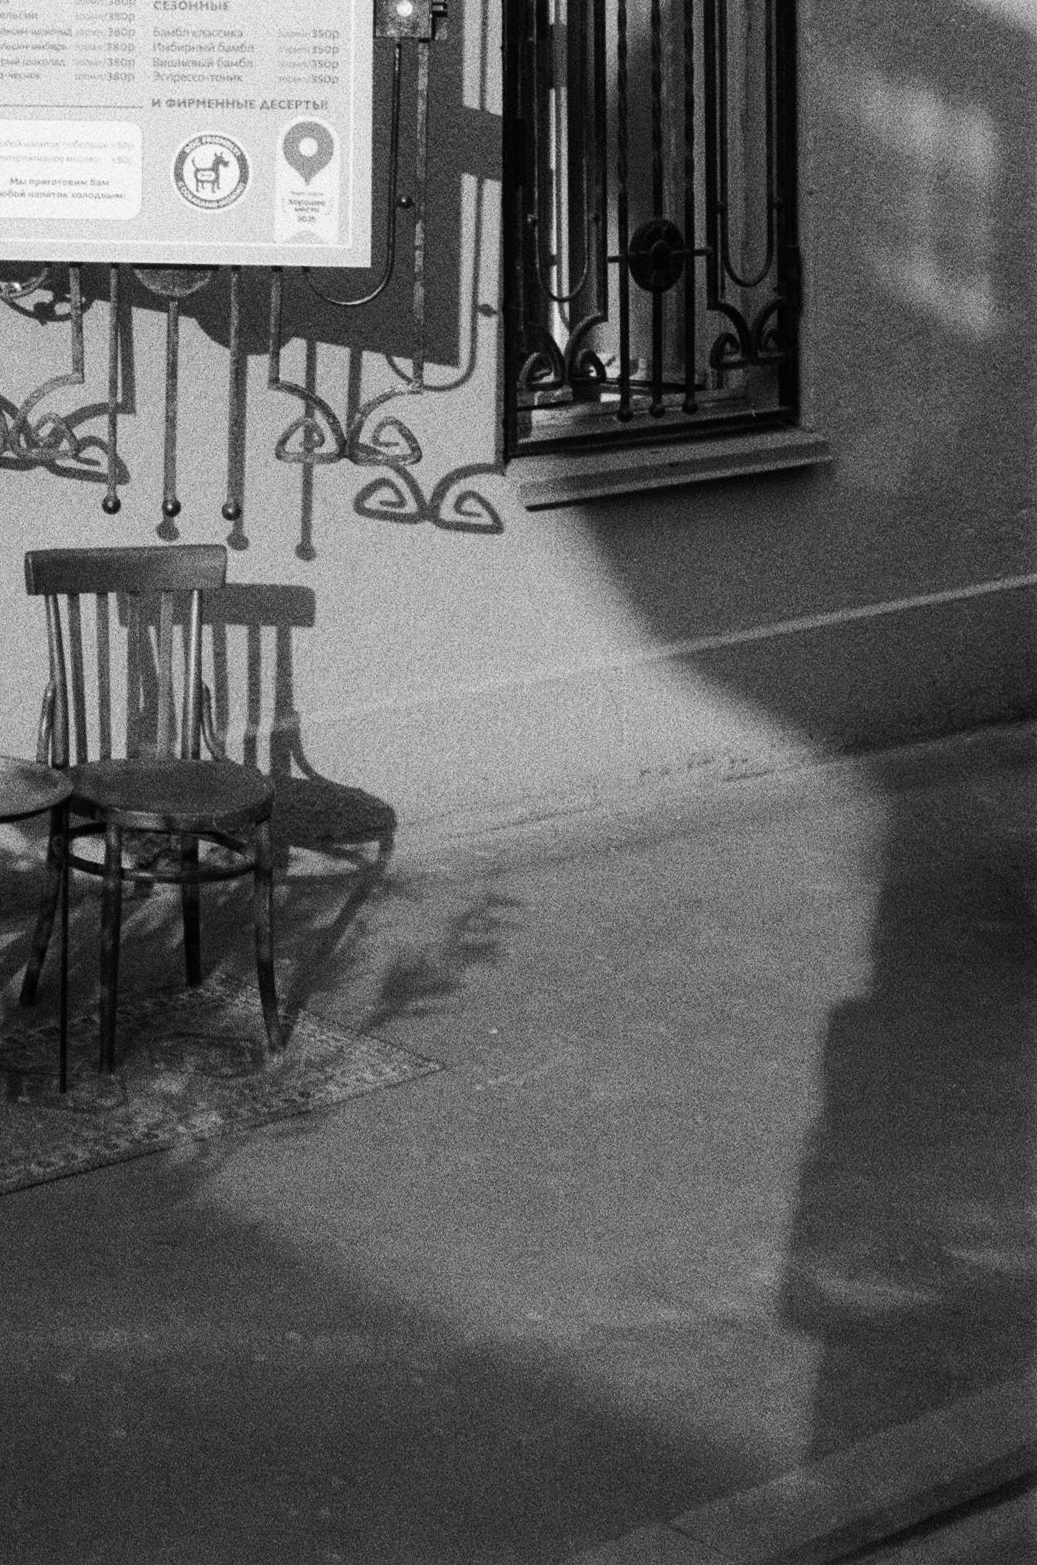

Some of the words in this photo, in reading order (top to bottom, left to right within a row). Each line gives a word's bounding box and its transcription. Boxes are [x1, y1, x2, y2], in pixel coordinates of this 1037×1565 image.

[153, 0, 230, 12] СЕЗОННЫЕ
[151, 98, 162, 109] И
[165, 98, 256, 110] ФИРМЕННЫЕ
